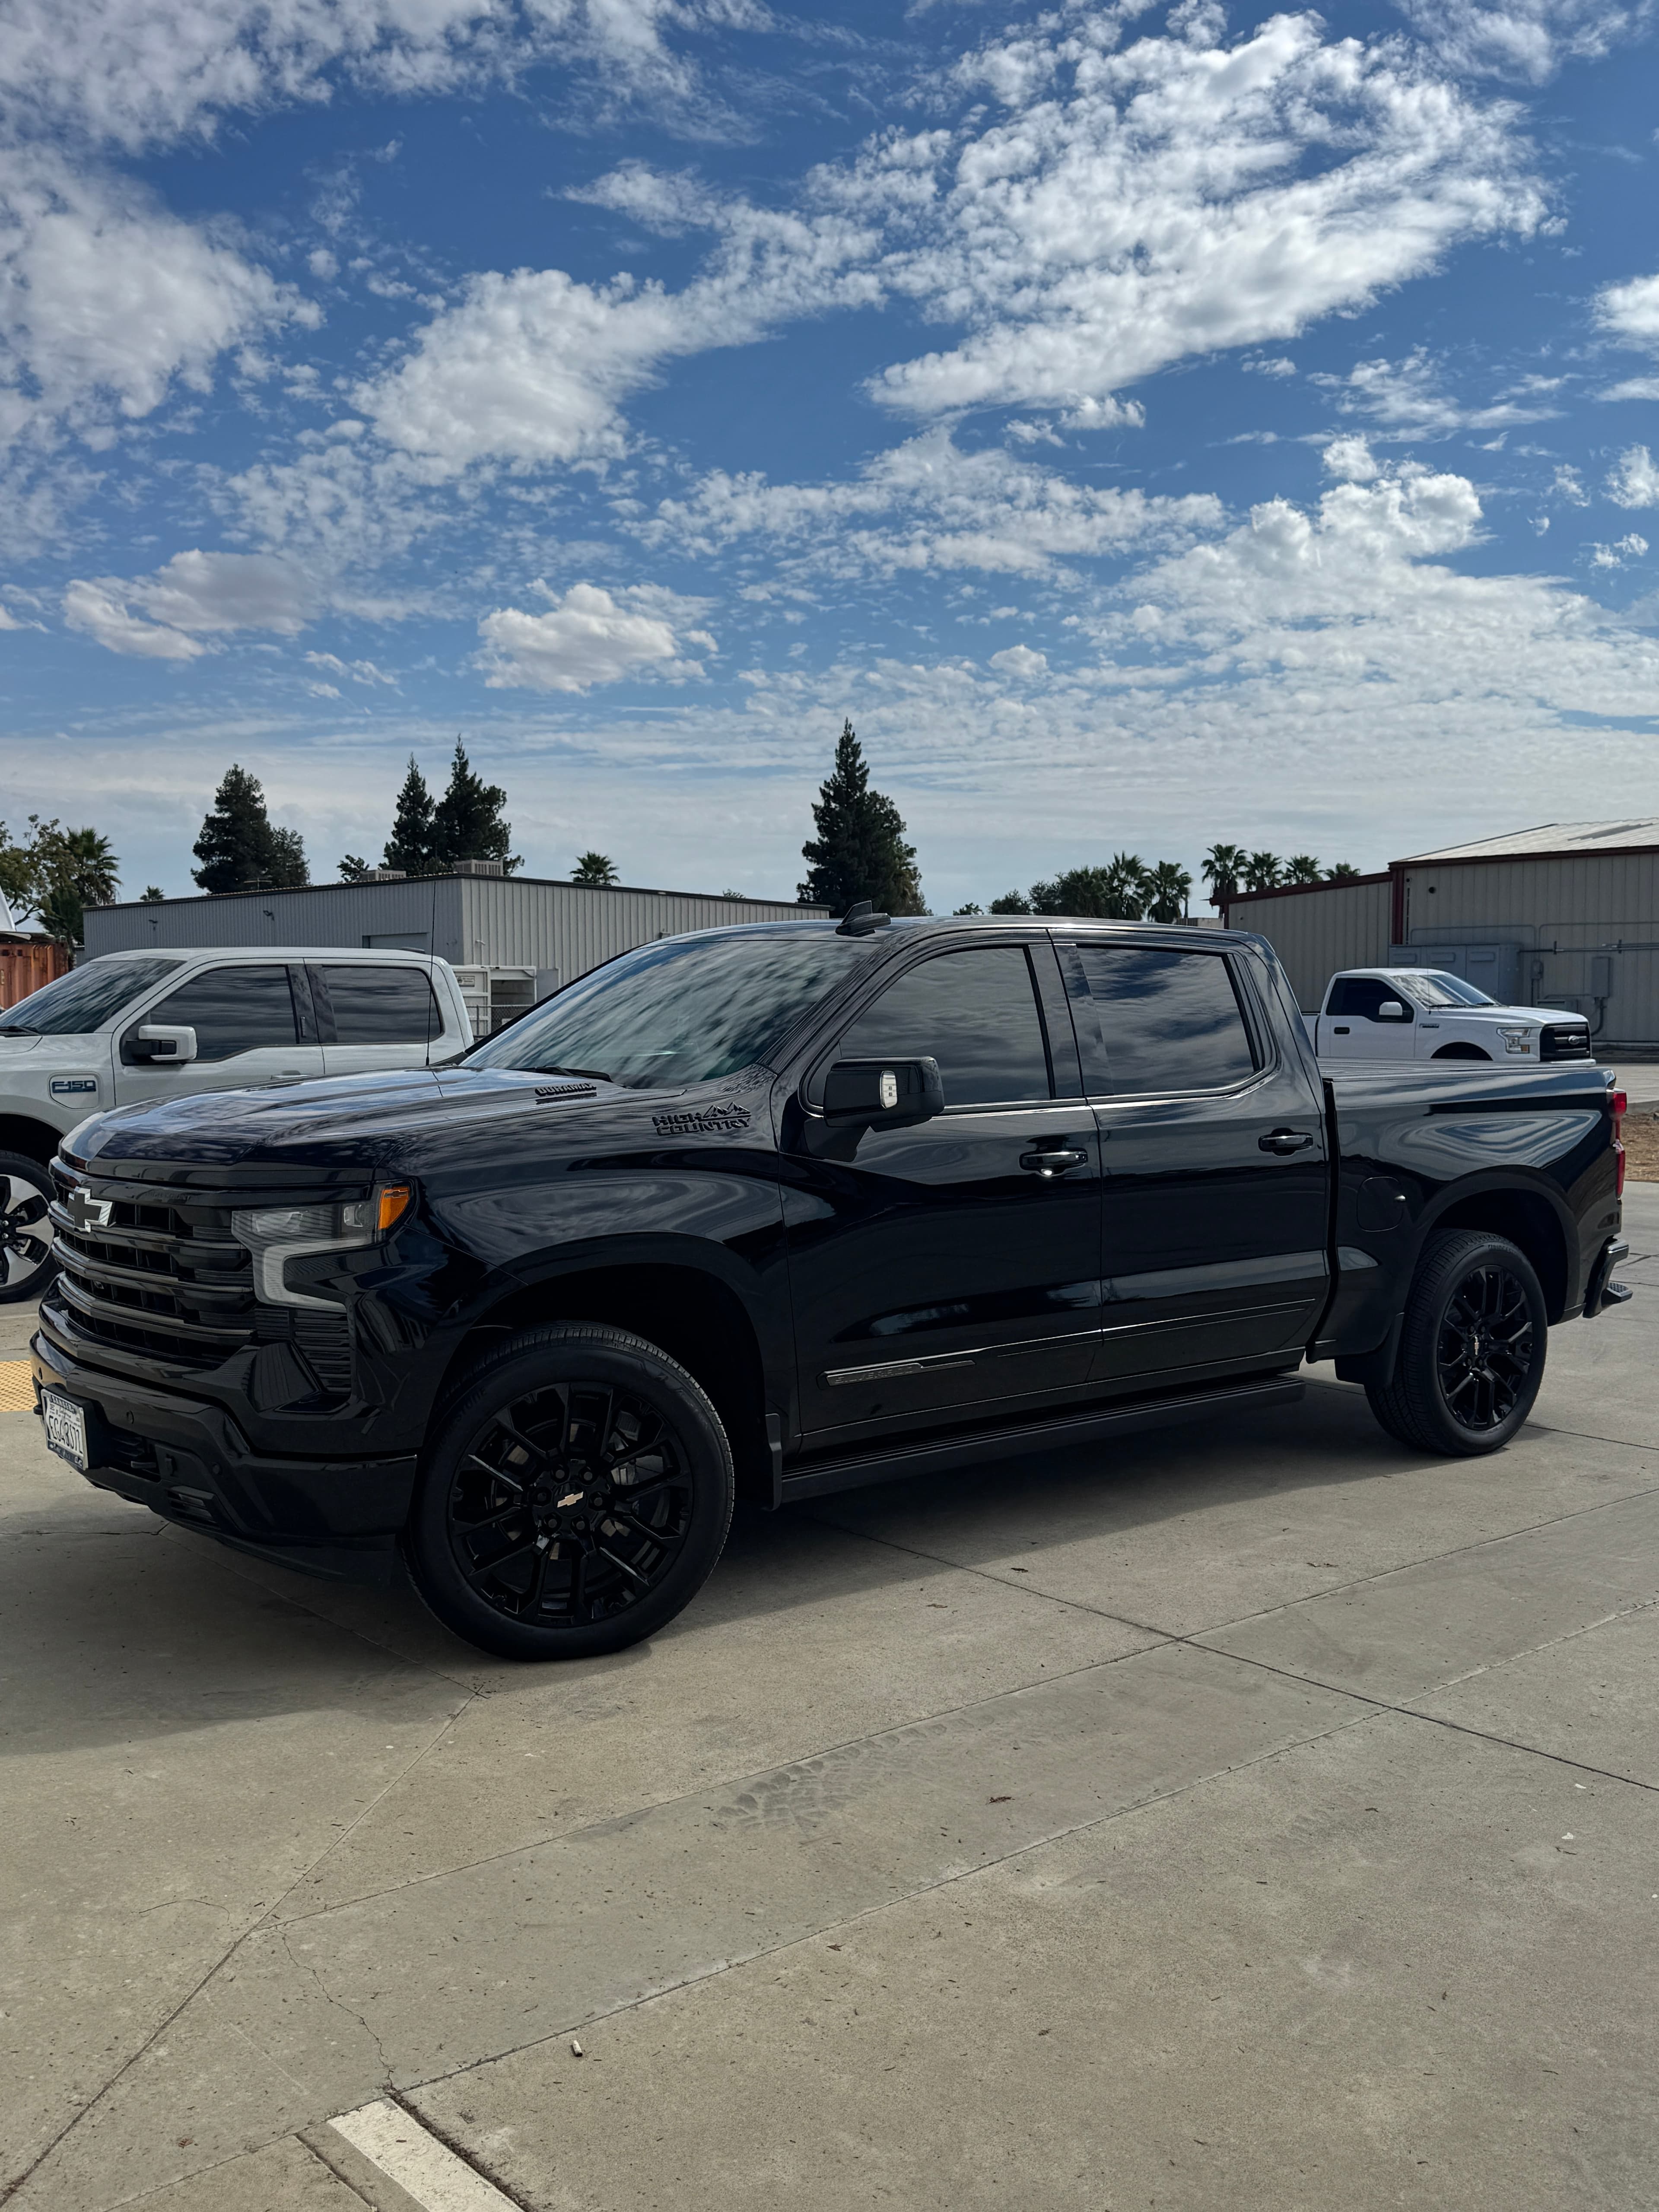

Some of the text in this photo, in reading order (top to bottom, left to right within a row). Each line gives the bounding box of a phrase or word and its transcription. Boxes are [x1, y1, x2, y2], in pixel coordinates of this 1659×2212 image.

[535, 1083, 597, 1096] DURAMAX
[652, 1112, 702, 1126] HIGH
[657, 1118, 751, 1136] COUNTRY
